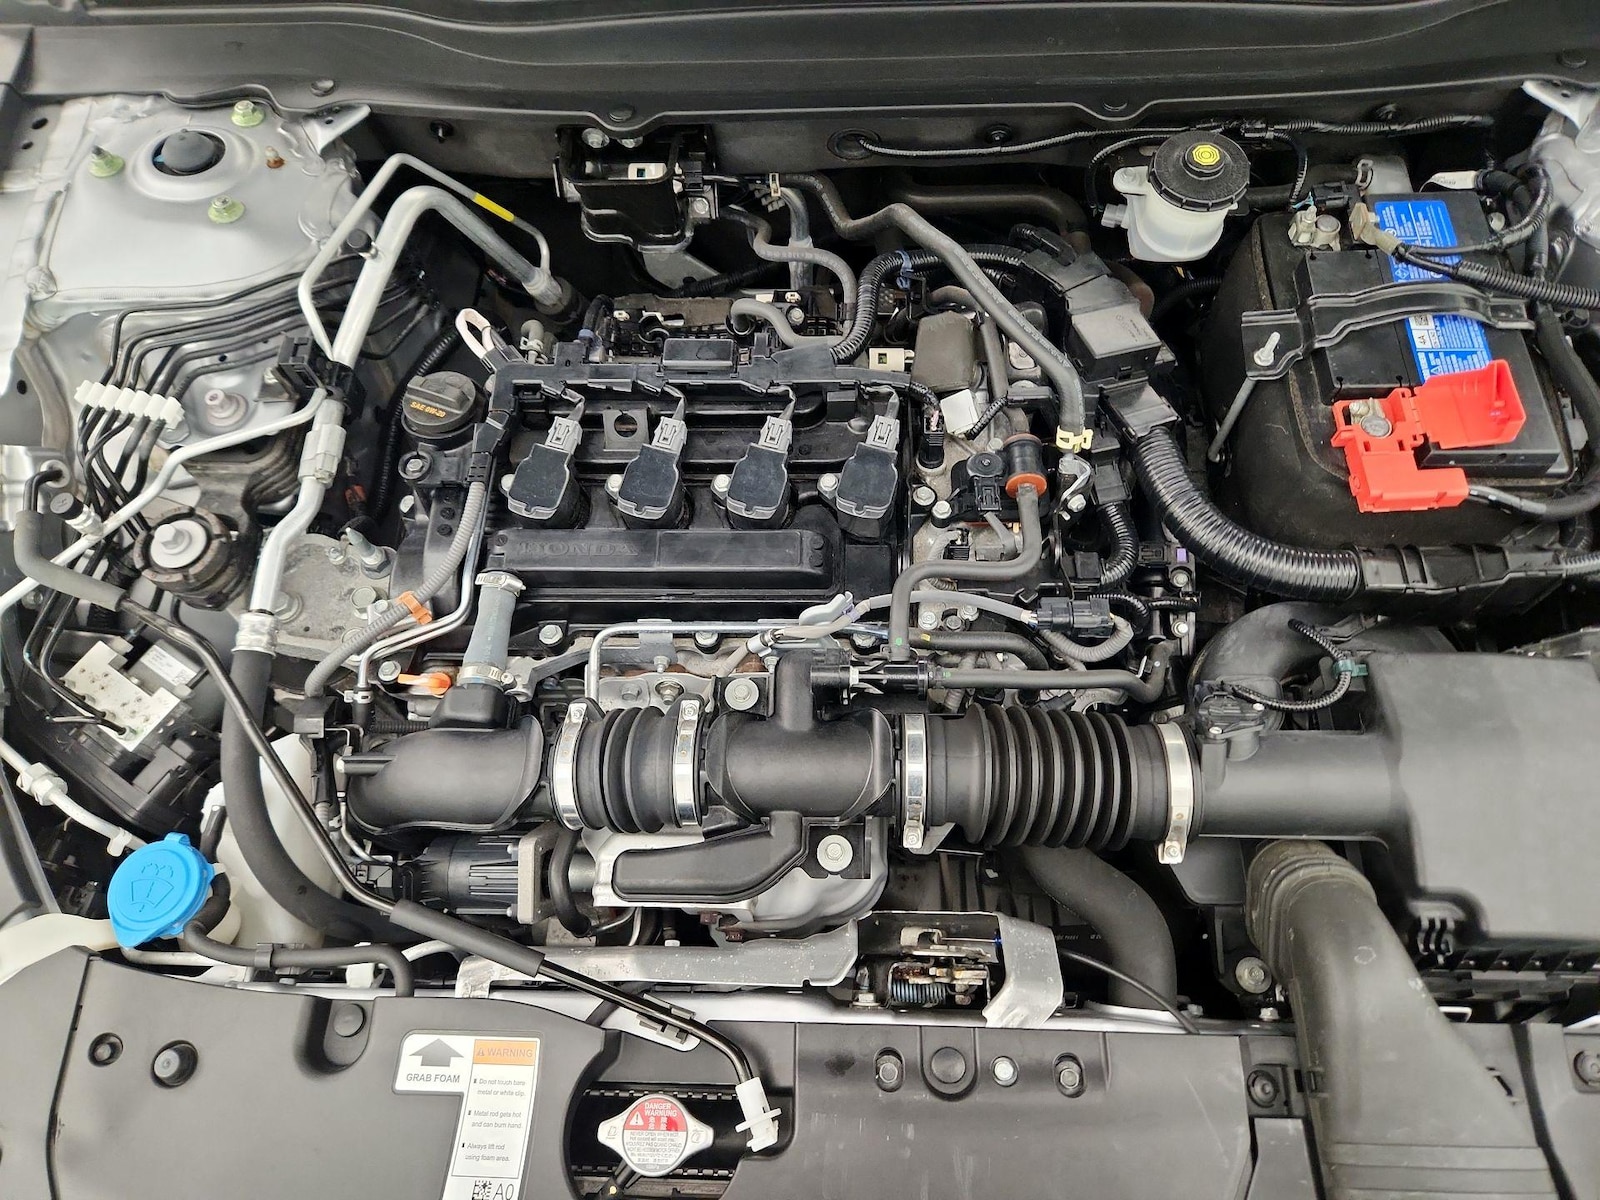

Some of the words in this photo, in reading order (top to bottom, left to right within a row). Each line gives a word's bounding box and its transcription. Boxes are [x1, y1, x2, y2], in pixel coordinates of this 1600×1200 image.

[410, 401, 426, 411] SAE
[425, 406, 446, 418] 0W-20
[519, 541, 639, 556] HONDA
[487, 1047, 533, 1058] WARNING
[406, 1073, 431, 1083] GRAB
[434, 1074, 460, 1083] FOAM
[644, 1102, 672, 1110] DANGER
[467, 1142, 487, 1150] Always
[465, 1154, 480, 1162] using
